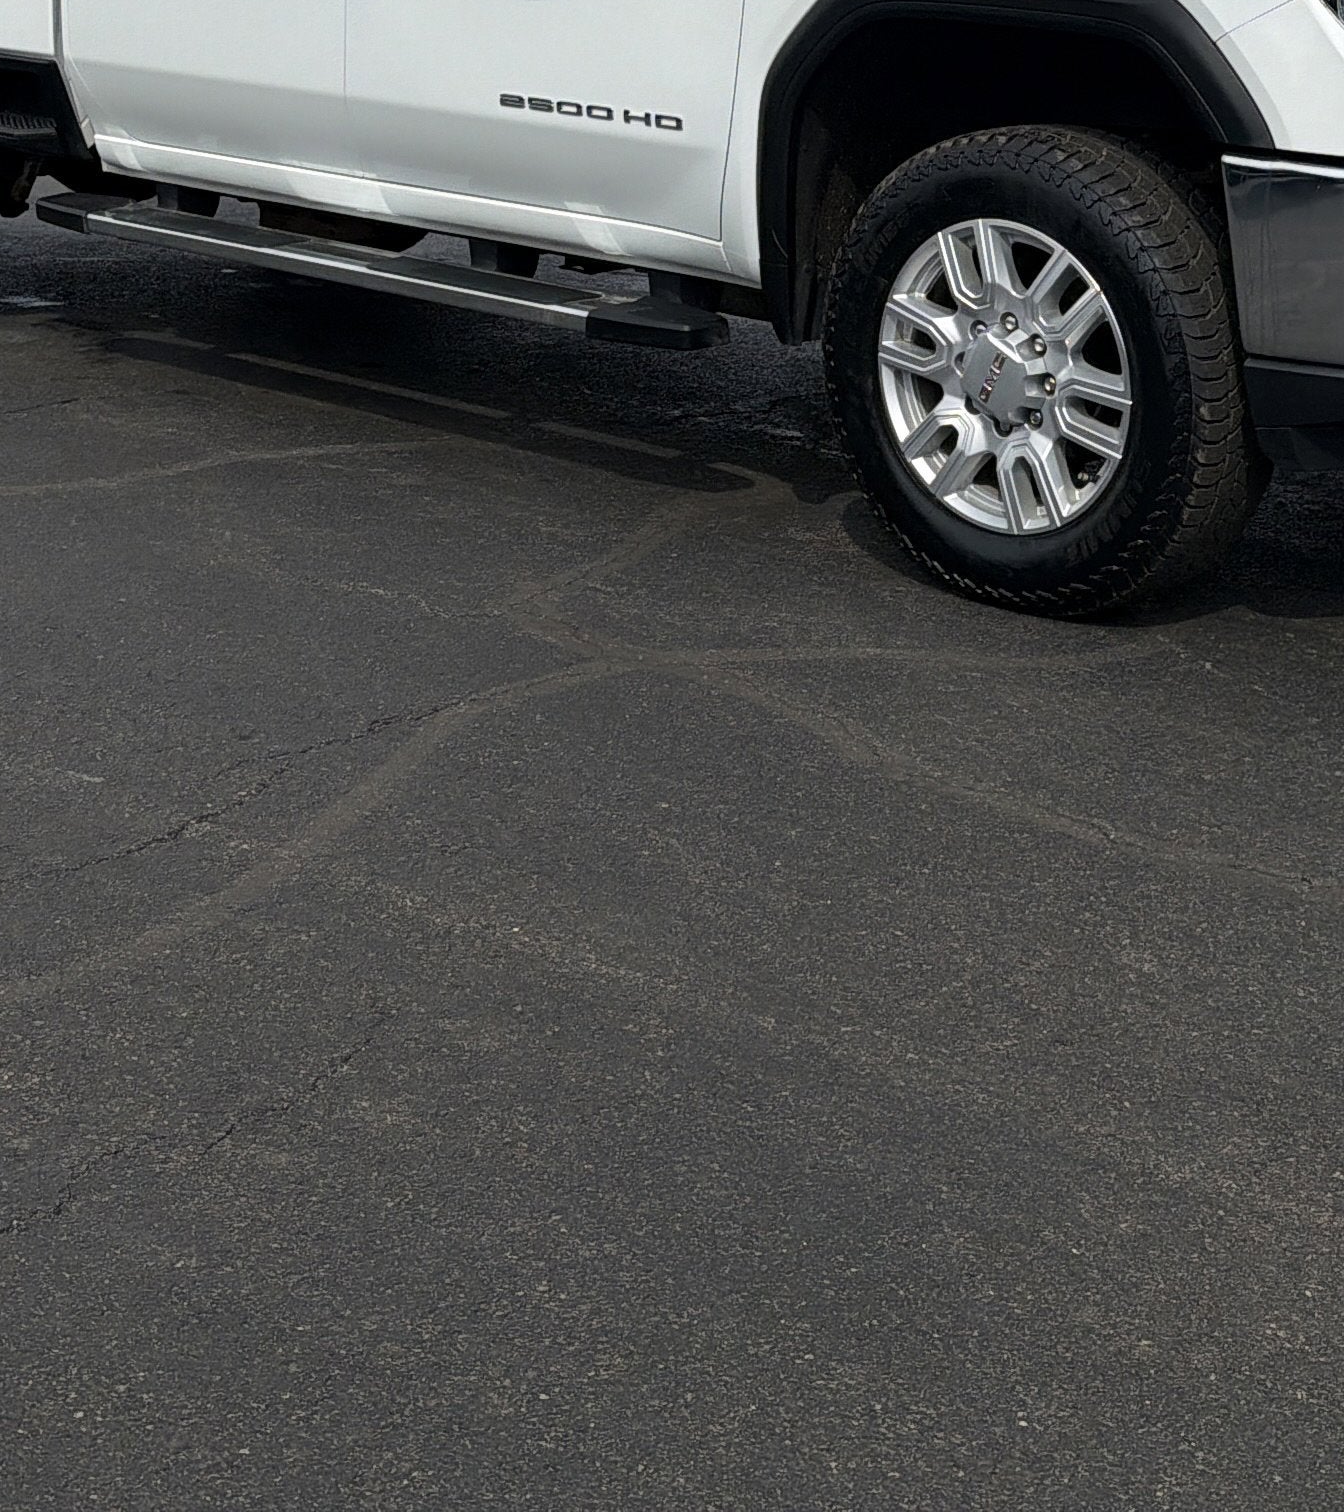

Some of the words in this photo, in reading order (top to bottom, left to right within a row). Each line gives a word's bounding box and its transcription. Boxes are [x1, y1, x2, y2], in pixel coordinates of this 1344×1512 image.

[499, 93, 614, 121] 2500
[623, 109, 684, 131] HD
[979, 351, 1007, 404] GMC
